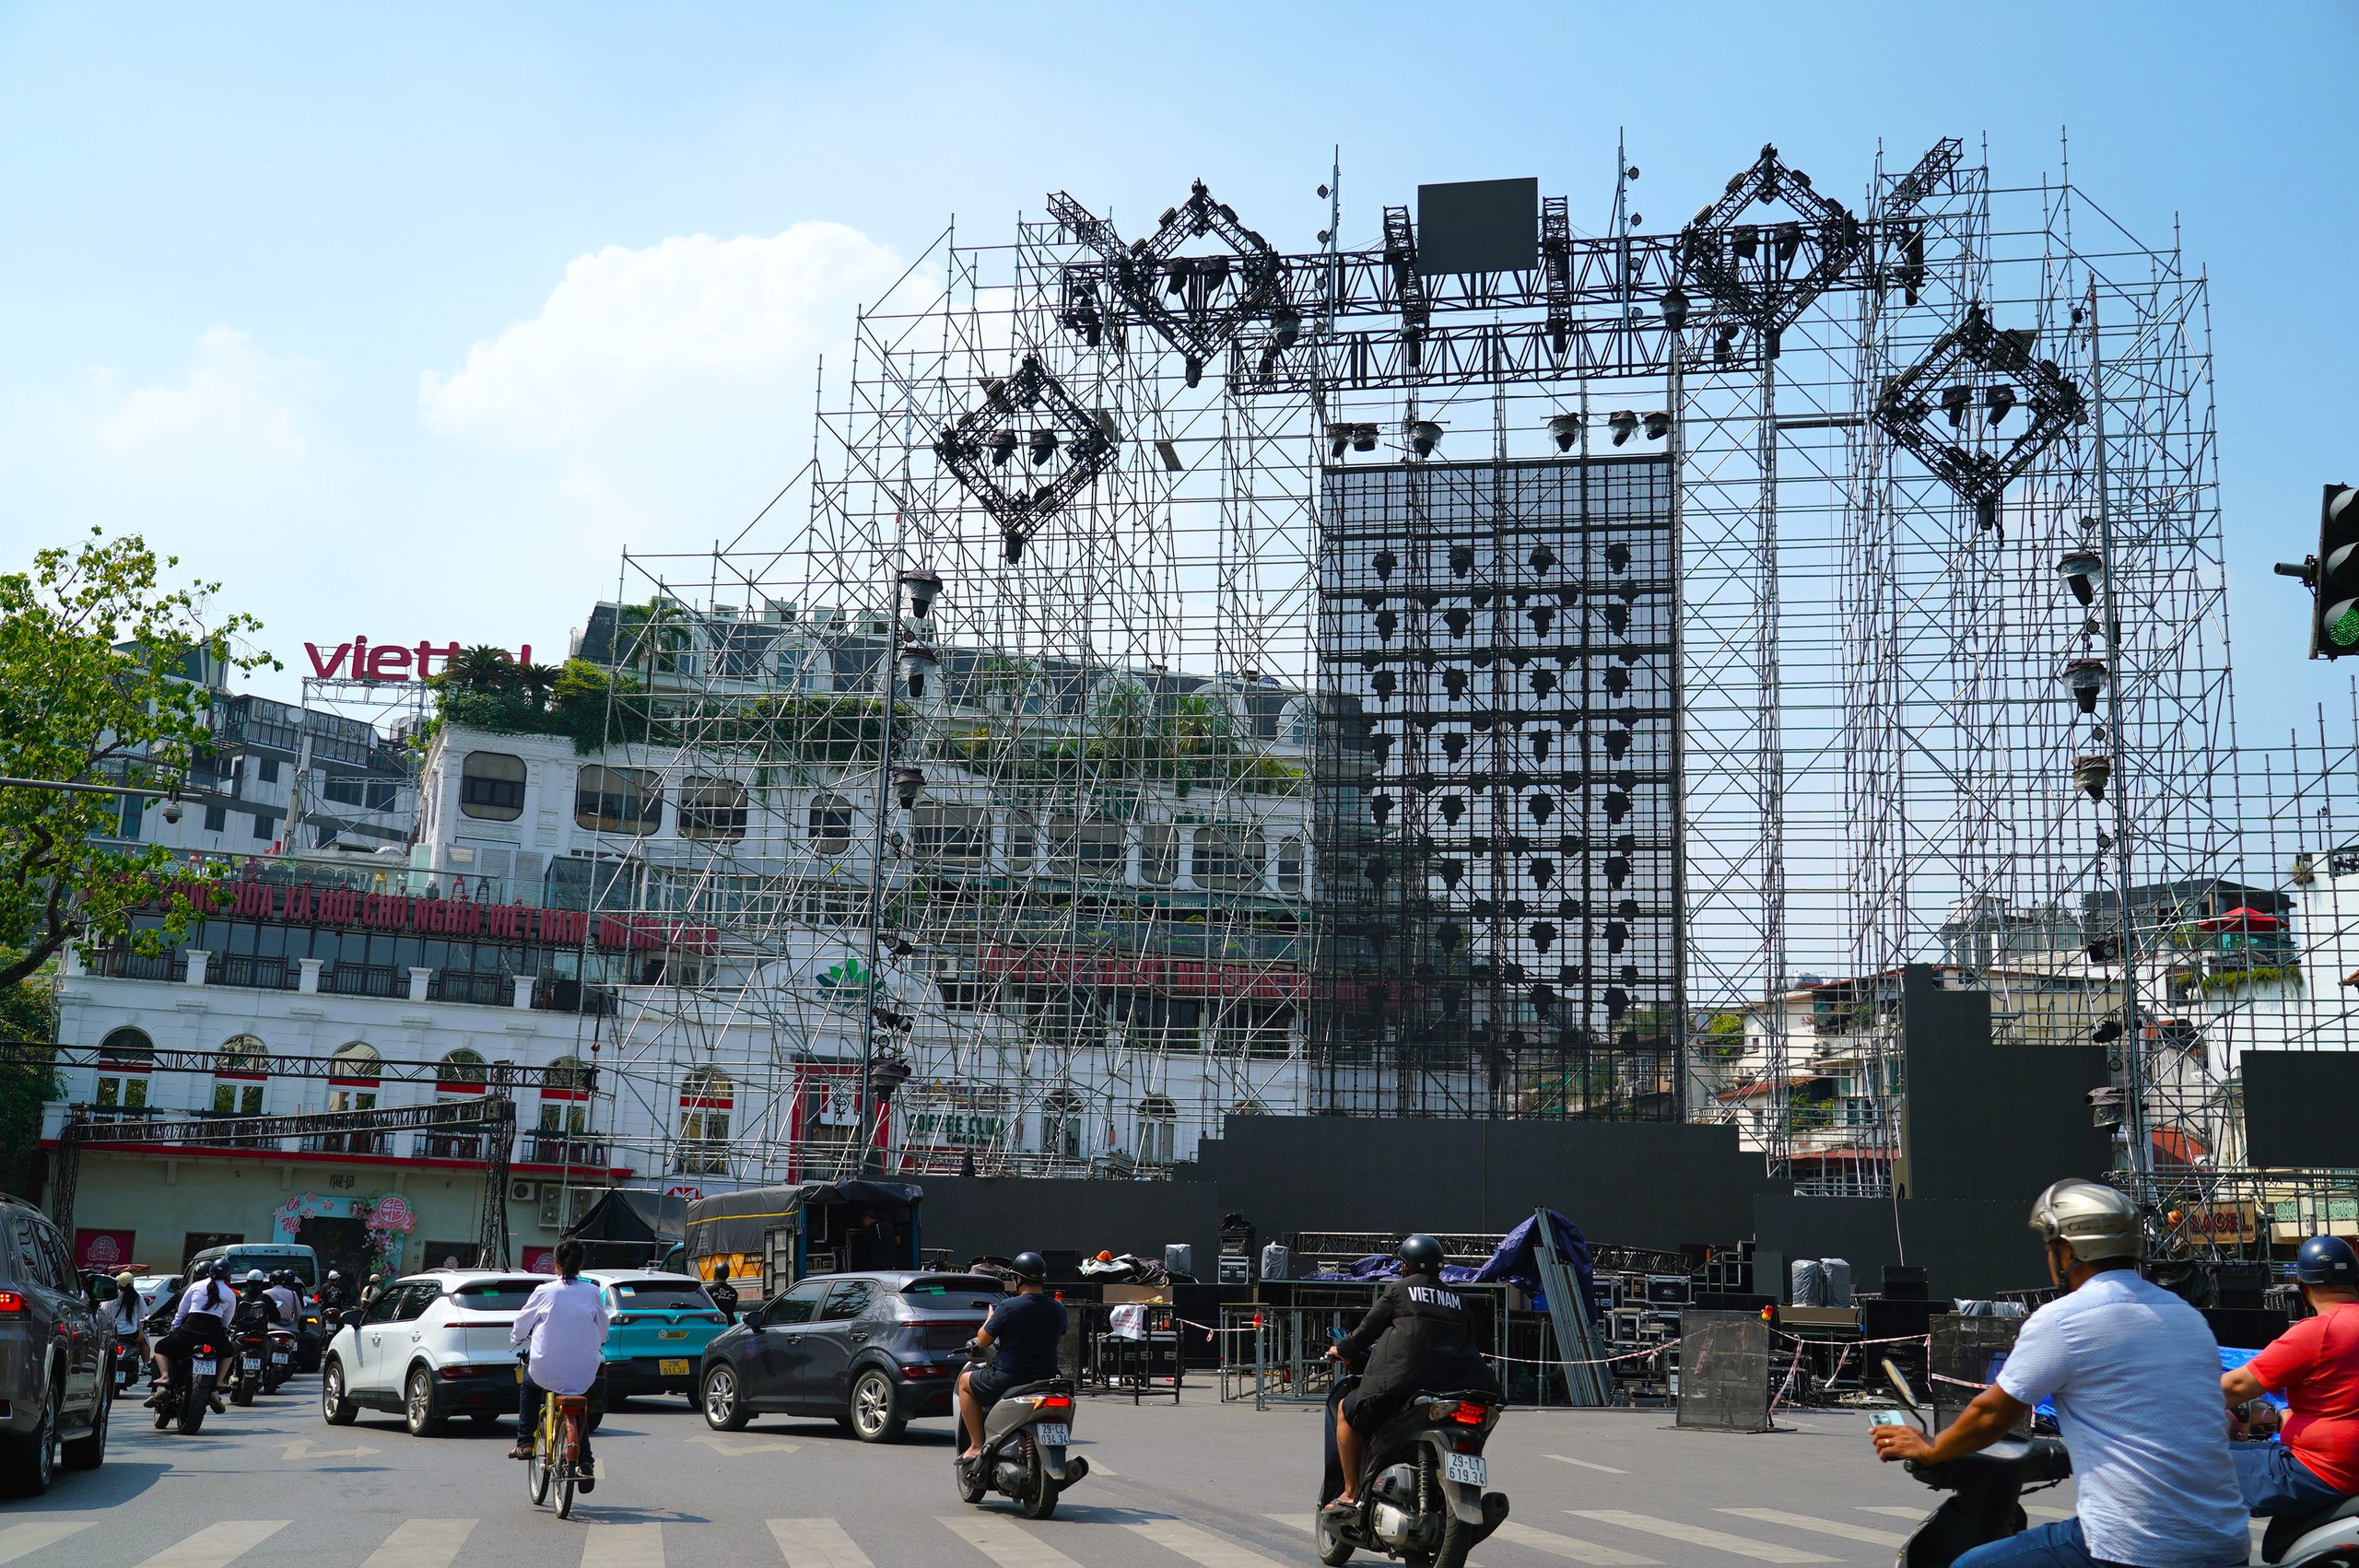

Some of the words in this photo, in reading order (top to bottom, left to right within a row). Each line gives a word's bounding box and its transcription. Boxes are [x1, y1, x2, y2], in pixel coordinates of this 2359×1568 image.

[303, 635, 532, 681] viettl
[362, 884, 408, 931] CHỦ
[414, 894, 480, 937] NGHĨA
[489, 898, 536, 949] VIỆT
[538, 908, 589, 946] NAM
[2189, 1211, 2252, 1233] BAGEL
[1407, 1286, 1436, 1304] VIET
[1437, 1289, 1461, 1310] NAM
[1042, 1424, 1064, 1434] 29-C2
[1041, 1434, 1069, 1445] 034.34
[1451, 1454, 1480, 1471] 29-L1
[1449, 1467, 1485, 1485] 619.34
